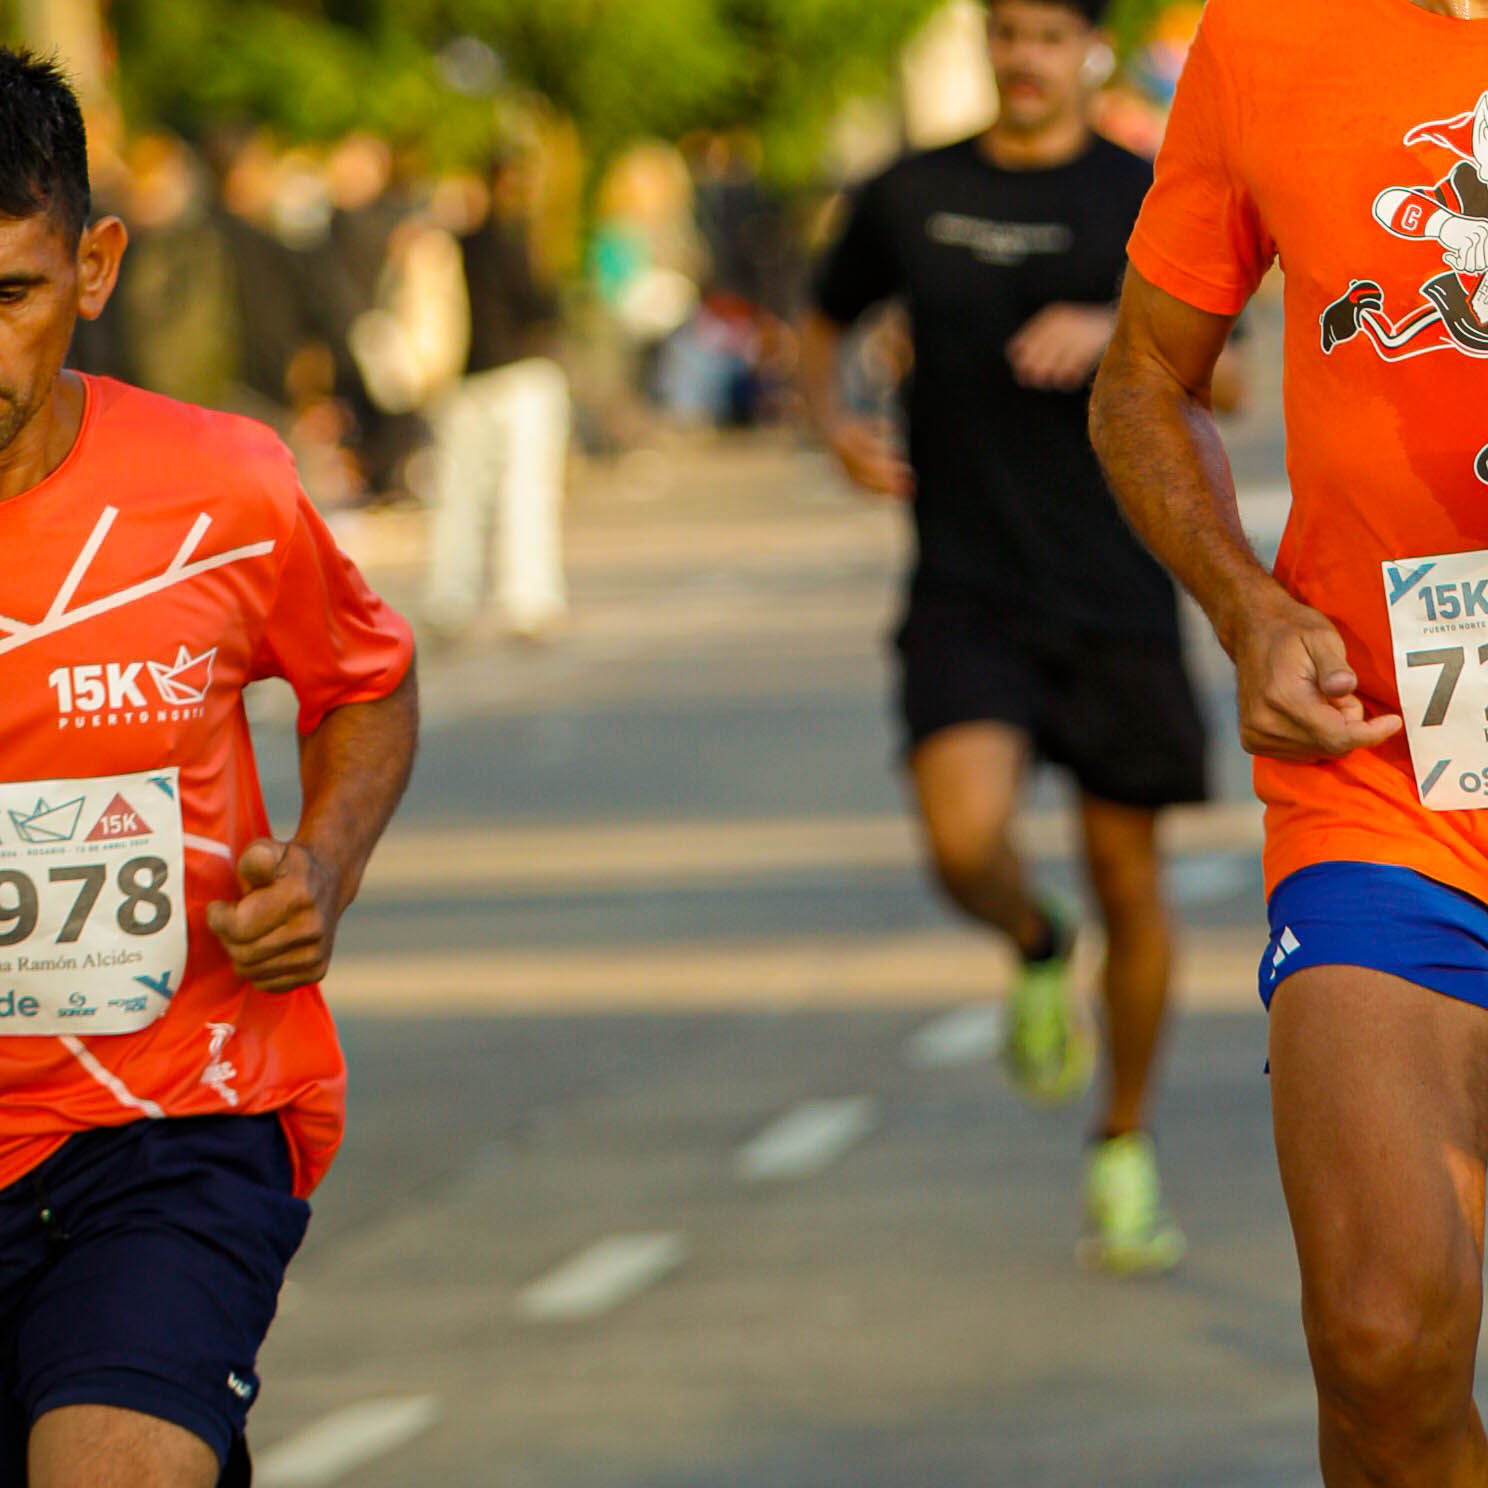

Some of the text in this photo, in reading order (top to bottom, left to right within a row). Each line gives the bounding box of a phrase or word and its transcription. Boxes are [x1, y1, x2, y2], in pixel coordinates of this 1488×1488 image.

[1423, 623, 1457, 634] PUERTO
[1459, 620, 1487, 631] NORTE
[48, 662, 148, 714] 15K
[58, 710, 150, 731] PUERTO
[101, 813, 138, 835] 15K
[0, 855, 172, 947] 978
[17, 955, 77, 972] Ramón
[82, 948, 144, 969] Alcides
